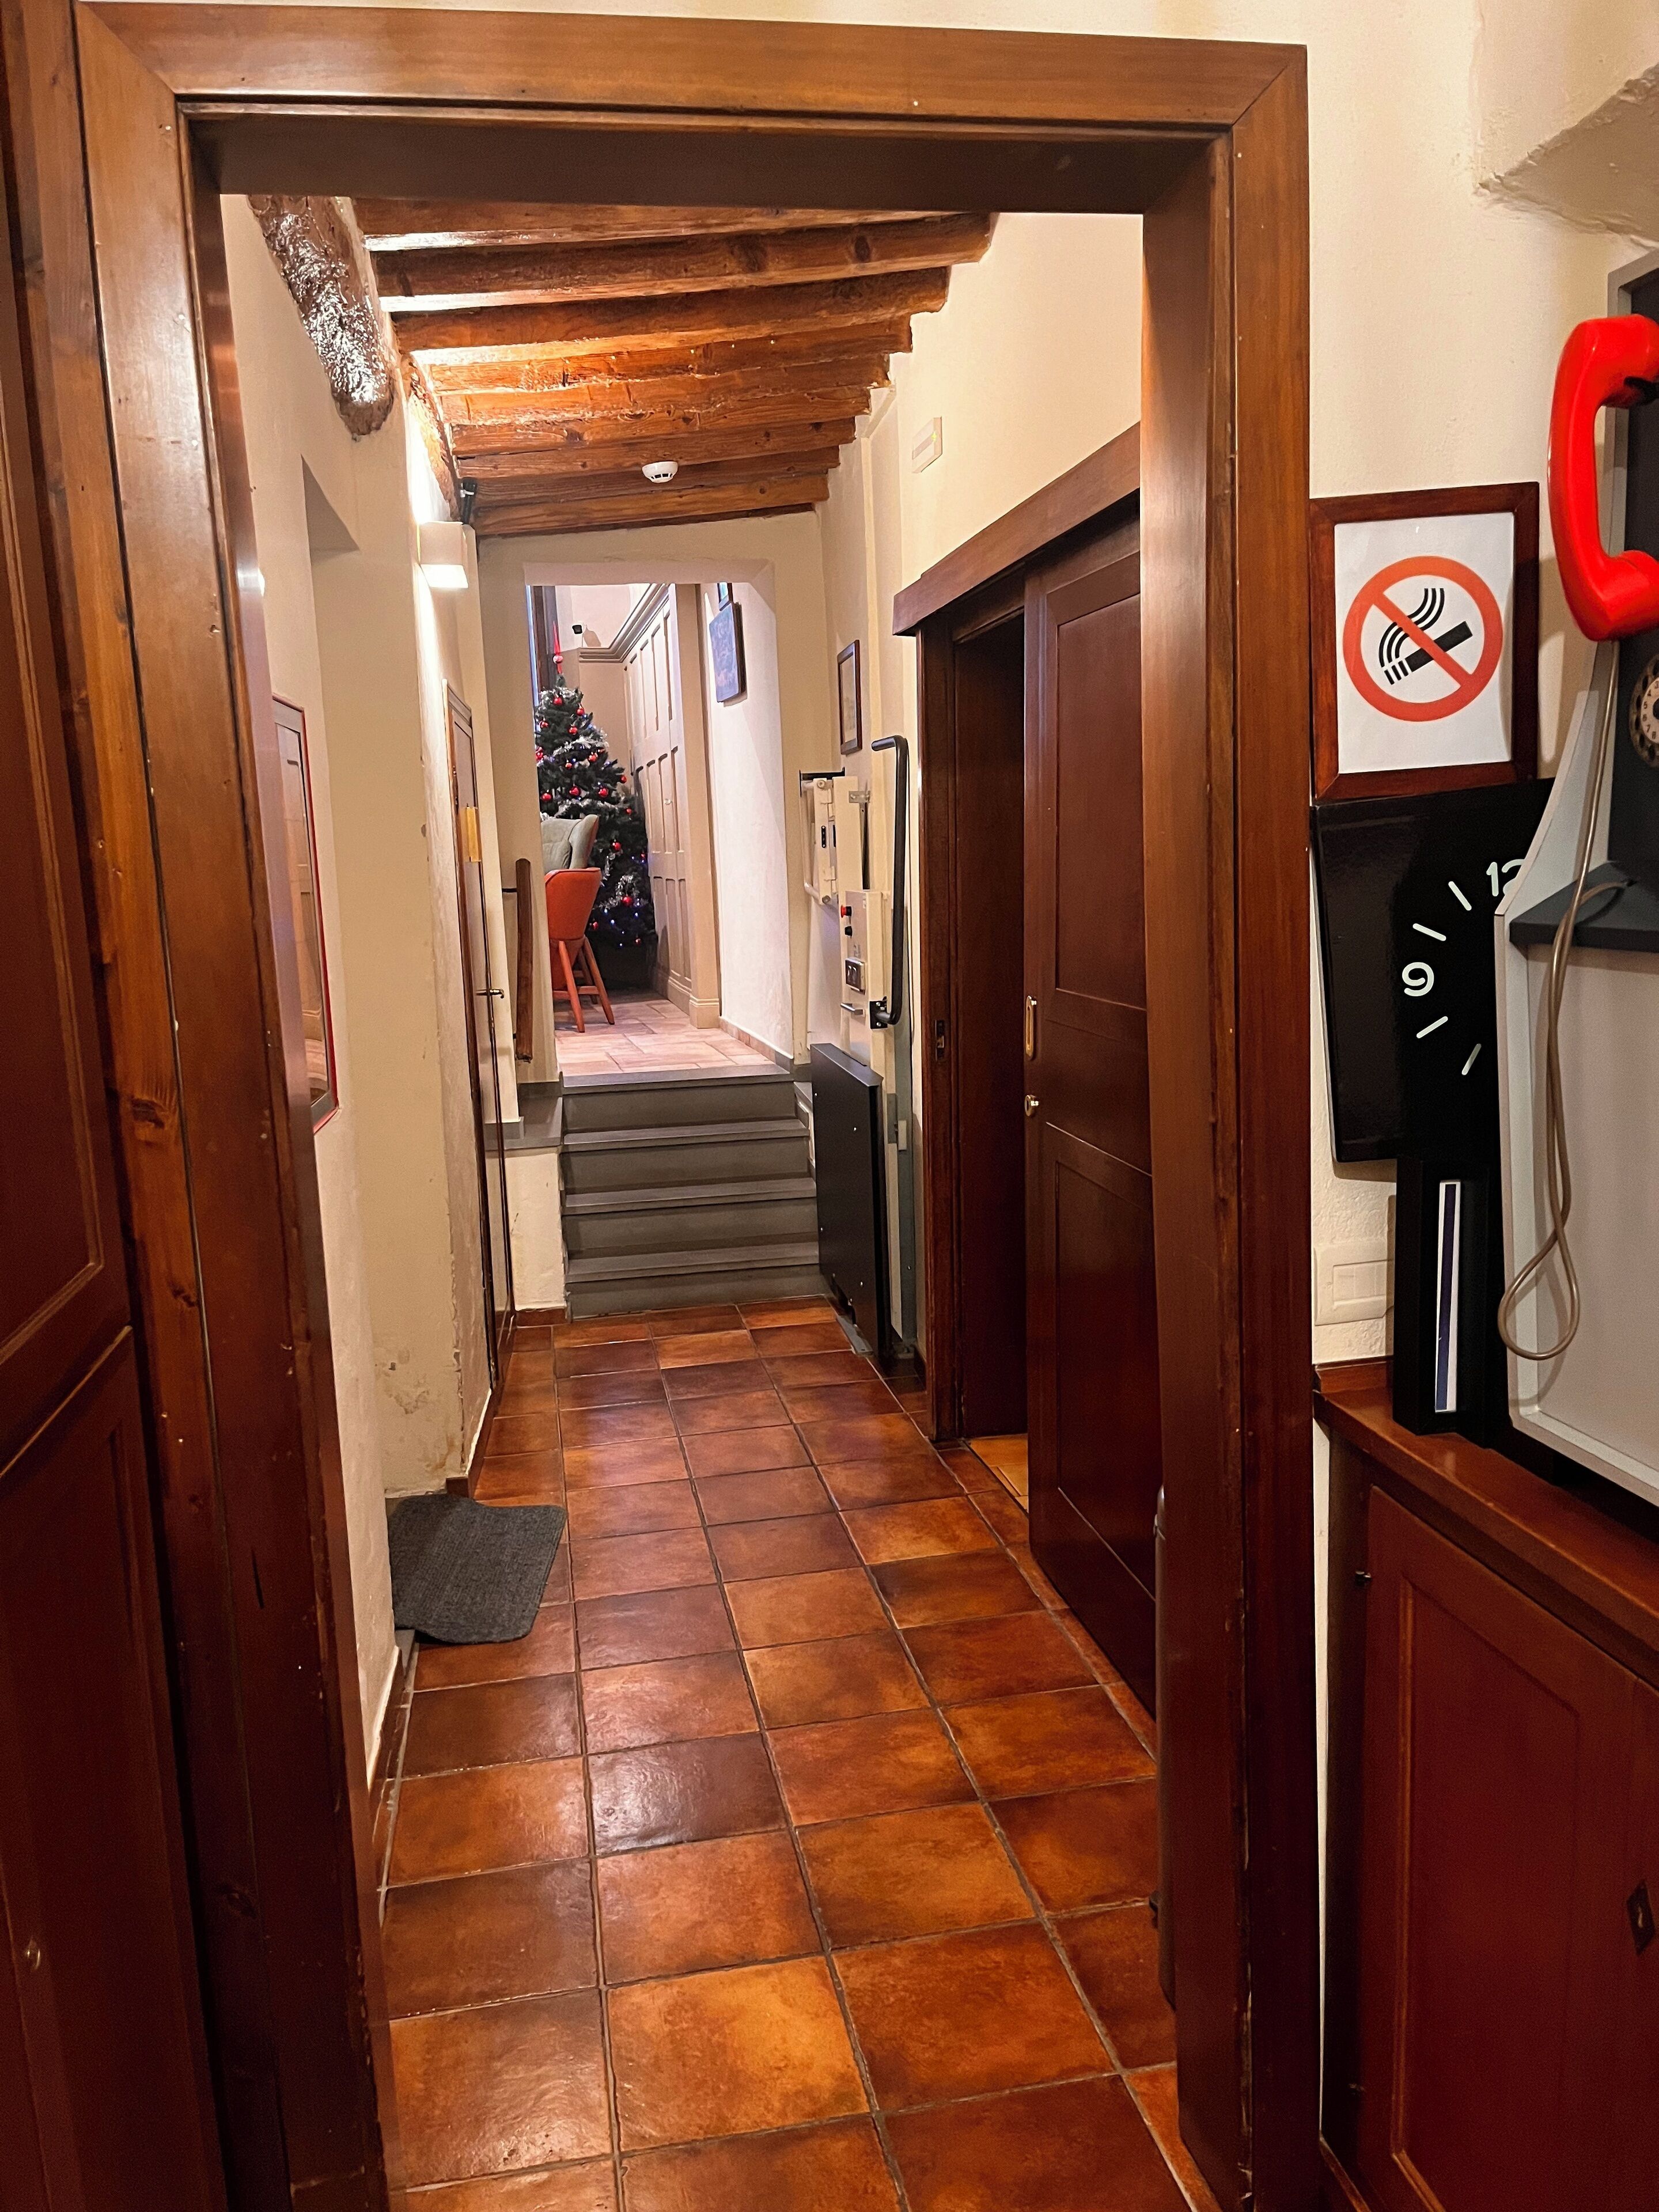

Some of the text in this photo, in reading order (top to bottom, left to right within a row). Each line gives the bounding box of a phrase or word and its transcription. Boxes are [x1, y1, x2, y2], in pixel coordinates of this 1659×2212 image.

[1643, 701, 1647, 709] 5
[1646, 724, 1650, 733] 7
[1402, 962, 1434, 997] 9
